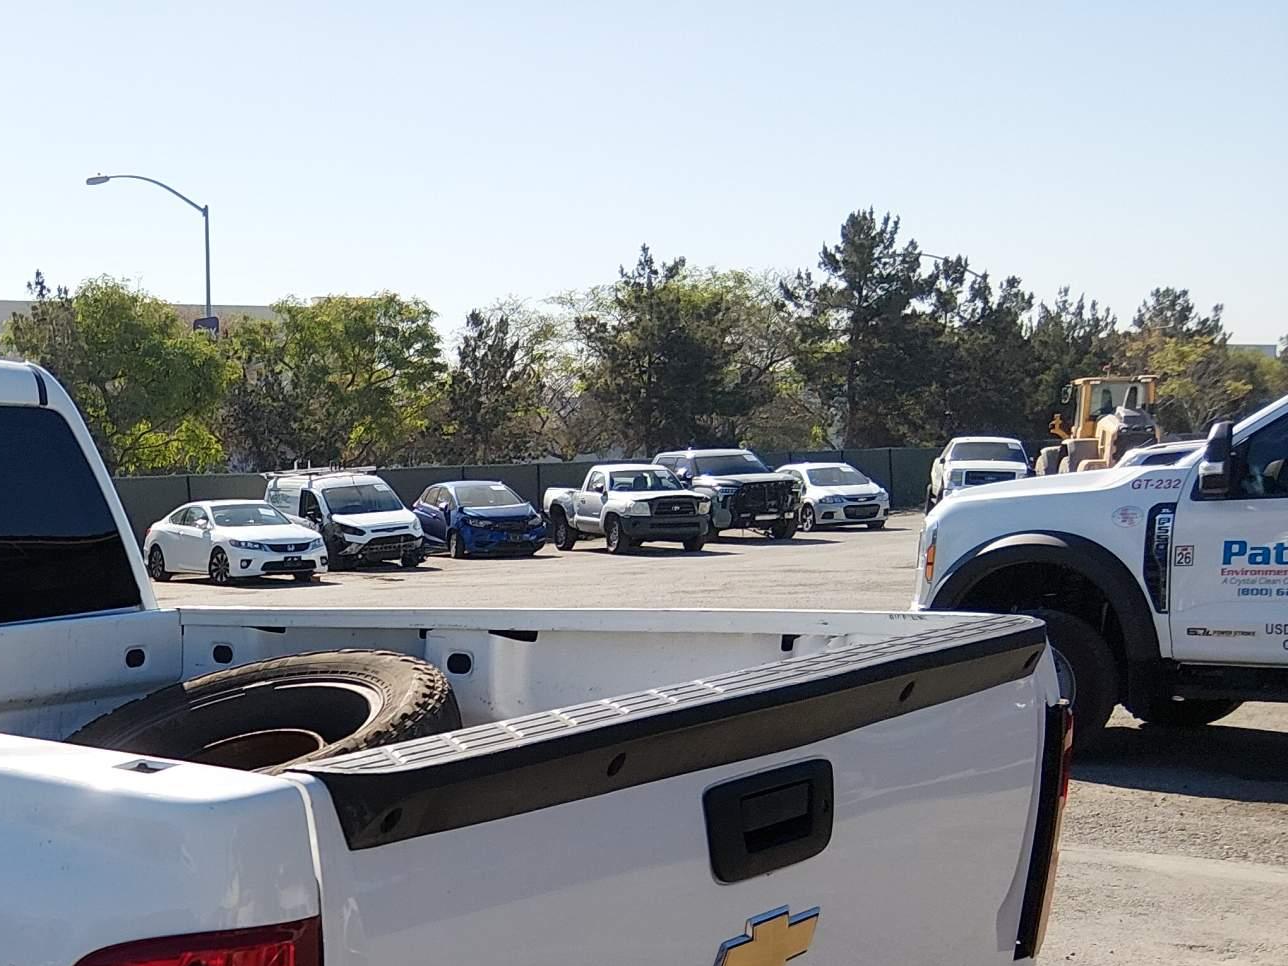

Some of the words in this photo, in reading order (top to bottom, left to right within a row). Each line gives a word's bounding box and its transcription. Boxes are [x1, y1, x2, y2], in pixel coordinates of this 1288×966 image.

[1132, 479, 1181, 490] GT-232
[1177, 551, 1192, 565] 26
[1222, 541, 1288, 566] Pat
[1238, 587, 1272, 597] (800)
